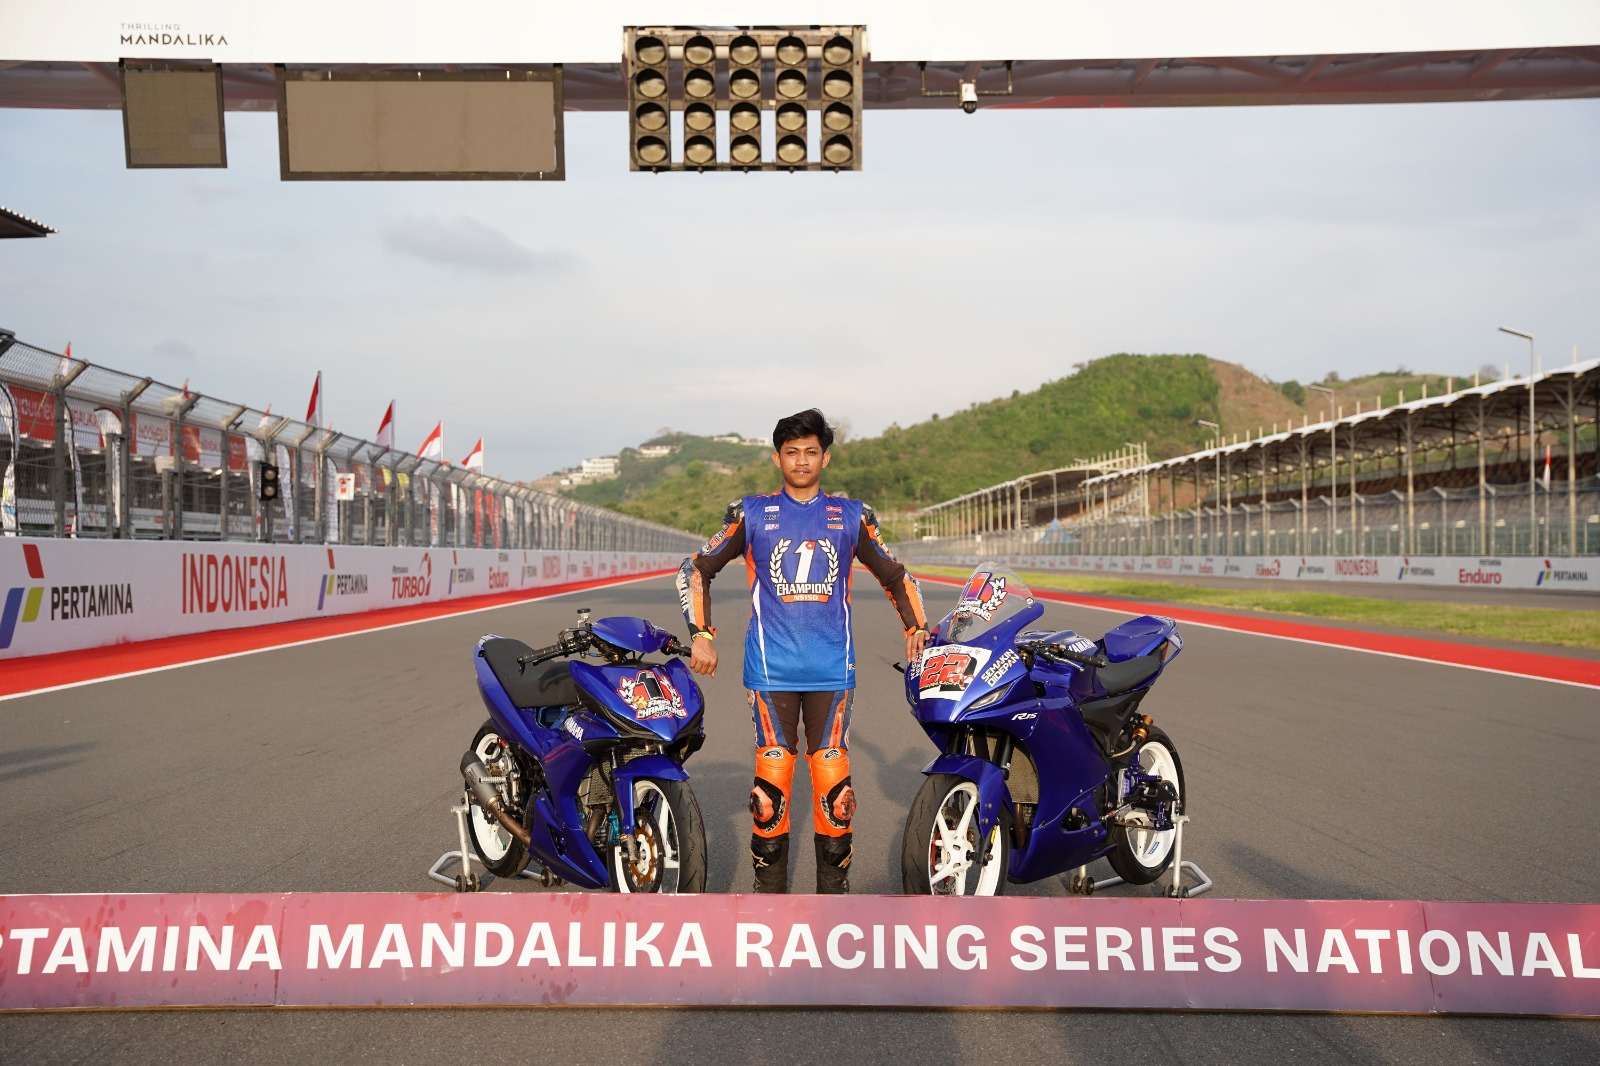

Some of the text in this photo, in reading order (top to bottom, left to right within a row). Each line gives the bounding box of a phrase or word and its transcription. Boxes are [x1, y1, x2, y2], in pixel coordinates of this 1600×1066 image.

[120, 23, 180, 31] THRILLING
[120, 33, 228, 46] MANDALIKA
[793, 540, 816, 584] 1
[1458, 569, 1502, 585] Enduro
[1553, 570, 1588, 582] PERTAMINA
[182, 553, 288, 615] INDONESIA
[337, 573, 369, 596] PERTAMINA
[392, 575, 425, 600] TURBO
[776, 583, 833, 596] CHAMPIONS
[51, 583, 134, 621] PERTAMINA
[919, 653, 972, 692] 22
[981, 648, 1015, 683] SEMAKIN
[987, 653, 1020, 688] DIDEPAN
[0, 922, 1600, 980] TAMINA MANDALIKA RACING SERIES NATIONAL
